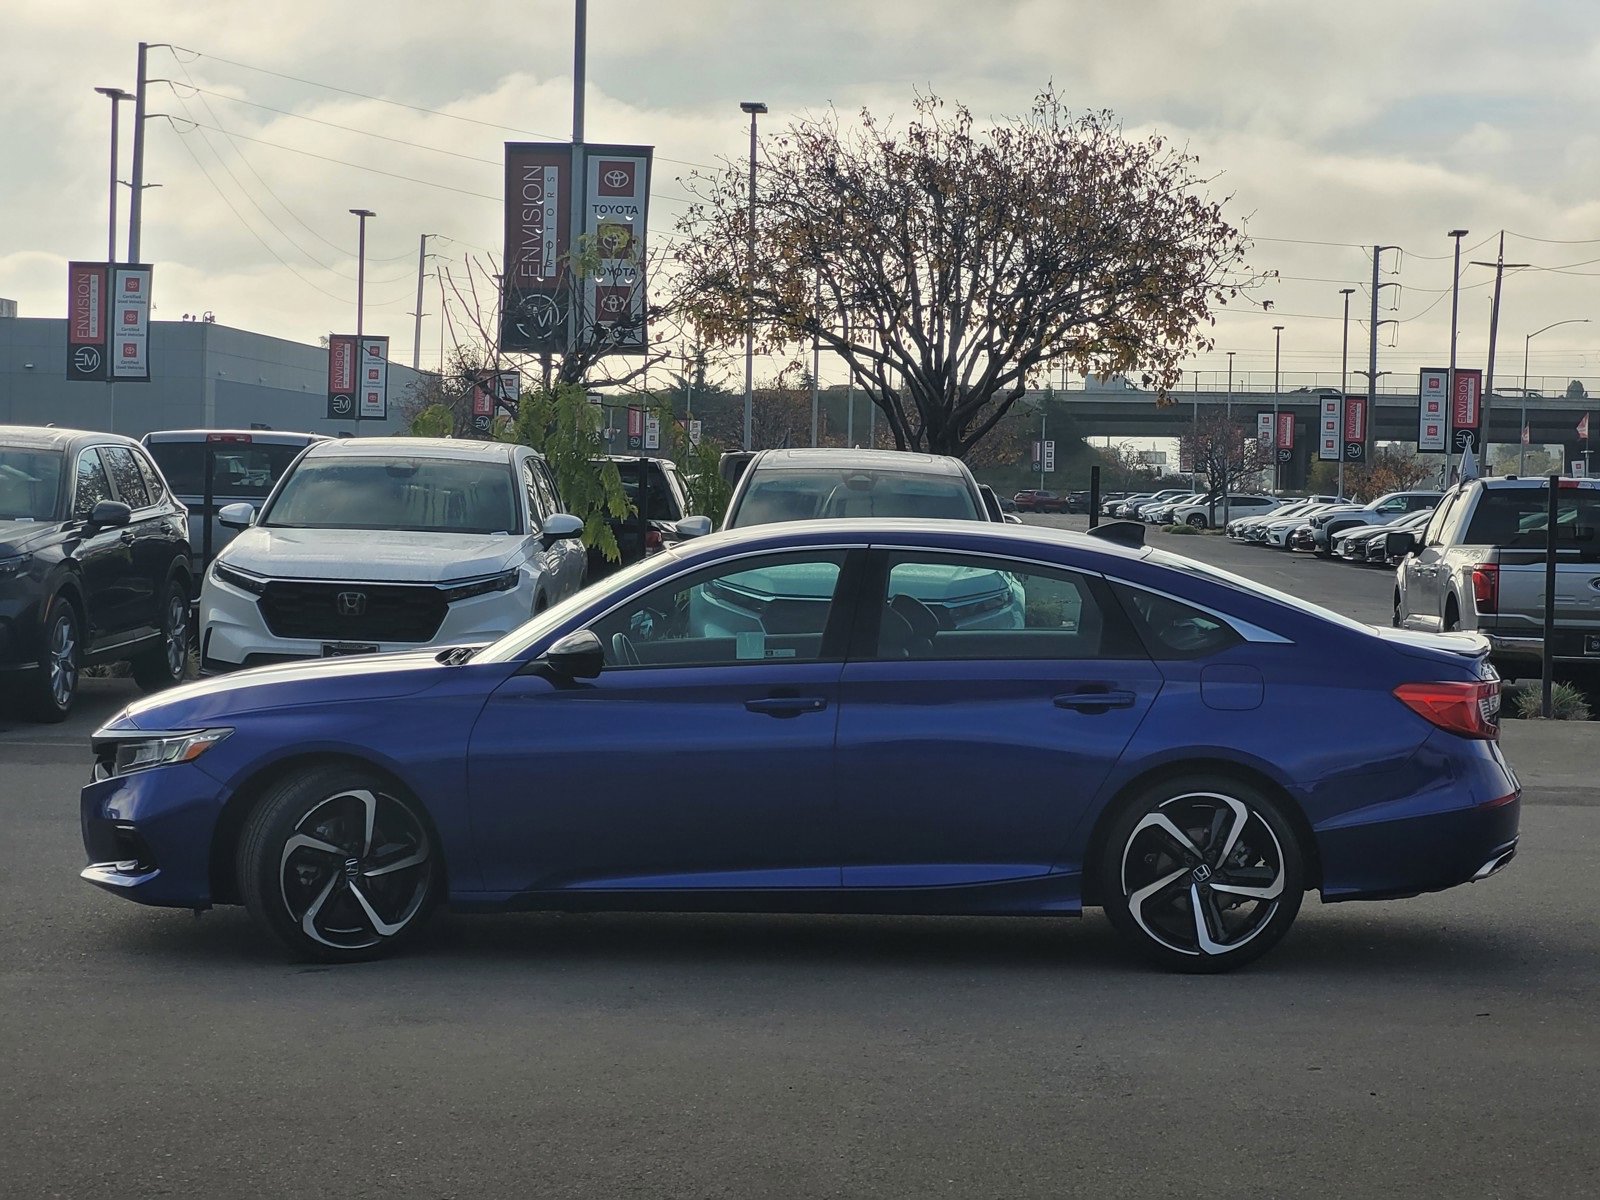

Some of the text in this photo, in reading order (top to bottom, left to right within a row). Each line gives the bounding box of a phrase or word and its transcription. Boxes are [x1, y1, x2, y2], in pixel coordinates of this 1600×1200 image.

[521, 165, 542, 277] ENVISION
[547, 176, 555, 268] MOTORS
[592, 204, 639, 215] TOYOTA
[77, 273, 90, 338] ENVISION
[334, 342, 344, 389] ENVISION
[1349, 402, 1358, 439] ENVISION
[1458, 377, 1468, 423] ENVISION
